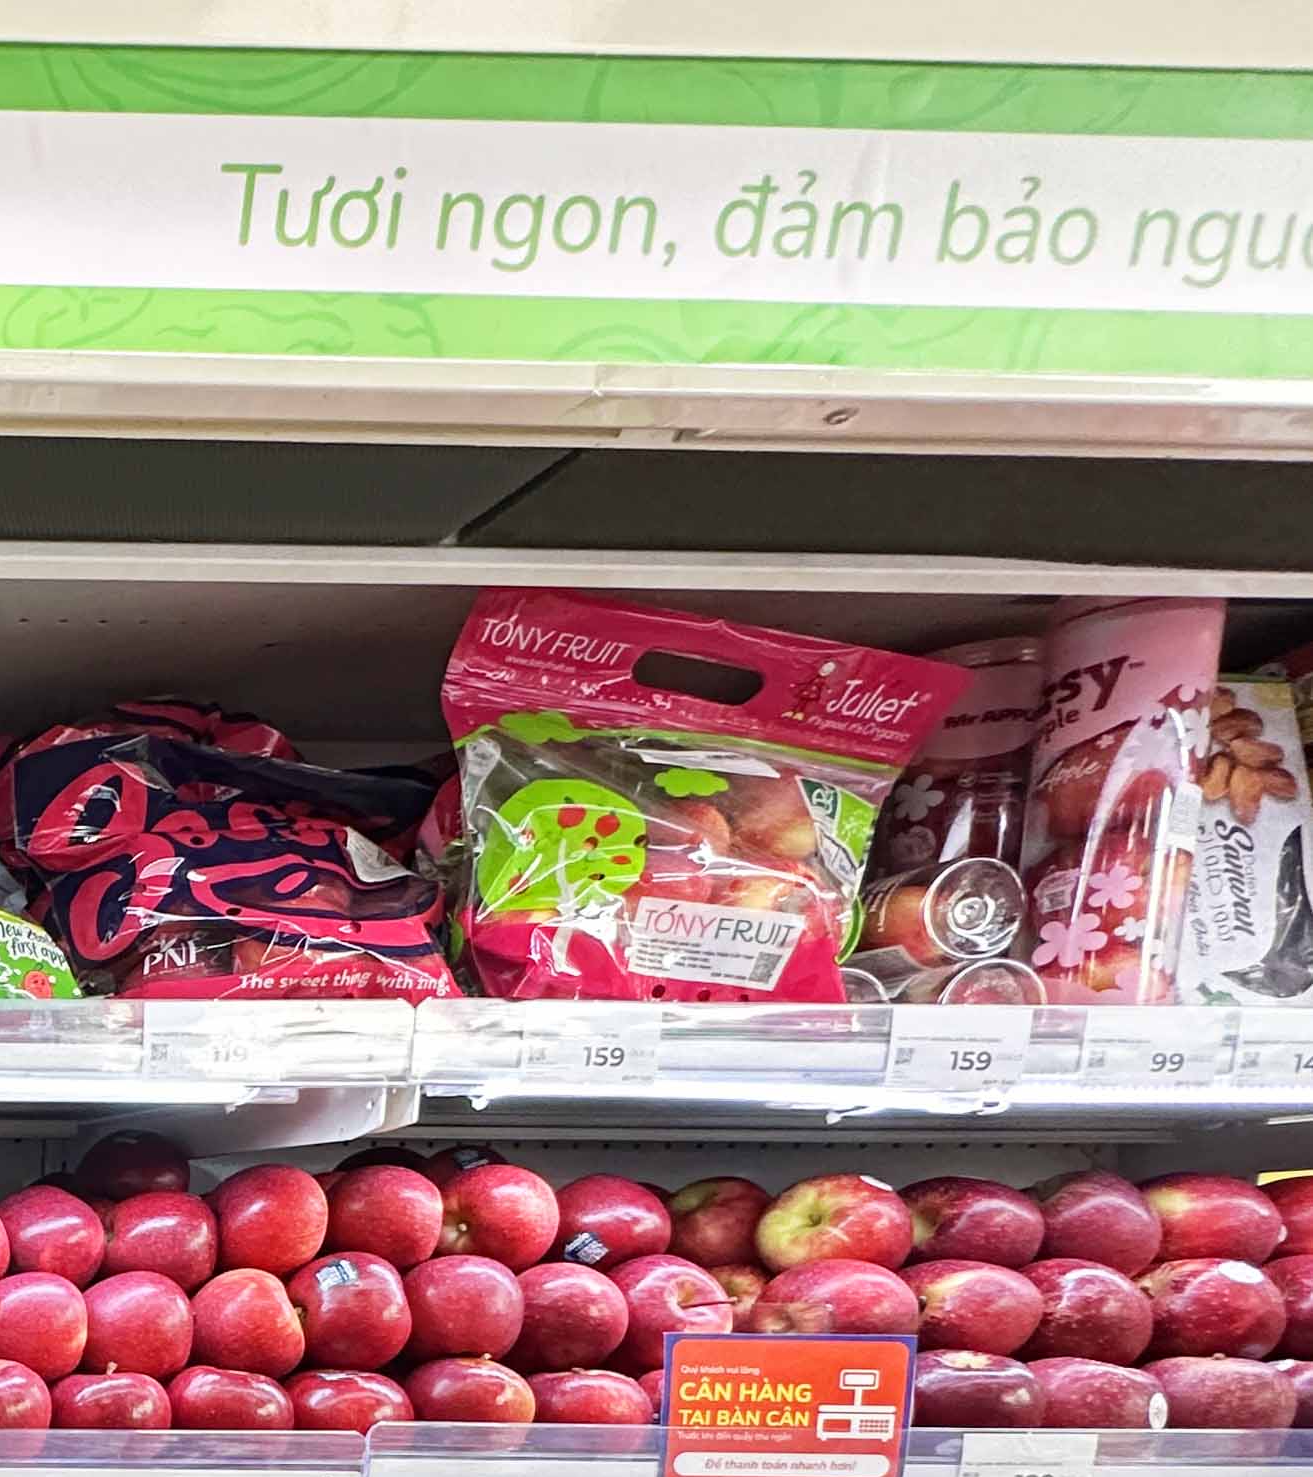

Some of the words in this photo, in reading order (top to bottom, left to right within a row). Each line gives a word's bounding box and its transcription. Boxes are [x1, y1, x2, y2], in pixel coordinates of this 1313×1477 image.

[221, 163, 408, 247] Tươi
[435, 190, 679, 273] ngon,
[715, 169, 903, 262] đảm
[937, 176, 1099, 265] bảo
[1128, 208, 1313, 289] ngu
[480, 615, 556, 653] TÓNY
[550, 630, 631, 666] FRUIT
[826, 680, 918, 723] Juliet
[644, 904, 720, 938] TÓNY
[715, 917, 796, 947] FRUIT
[240, 972, 276, 990] The
[377, 971, 414, 991] with
[584, 1047, 625, 1066] 159
[950, 1051, 992, 1070] 159
[1150, 1053, 1185, 1072] 99
[678, 1377, 732, 1402] CÂN
[739, 1378, 813, 1403] HÀNG
[678, 1408, 711, 1430] TẠI
[716, 1406, 762, 1426] BÀN
[765, 1406, 810, 1427] CÂN
